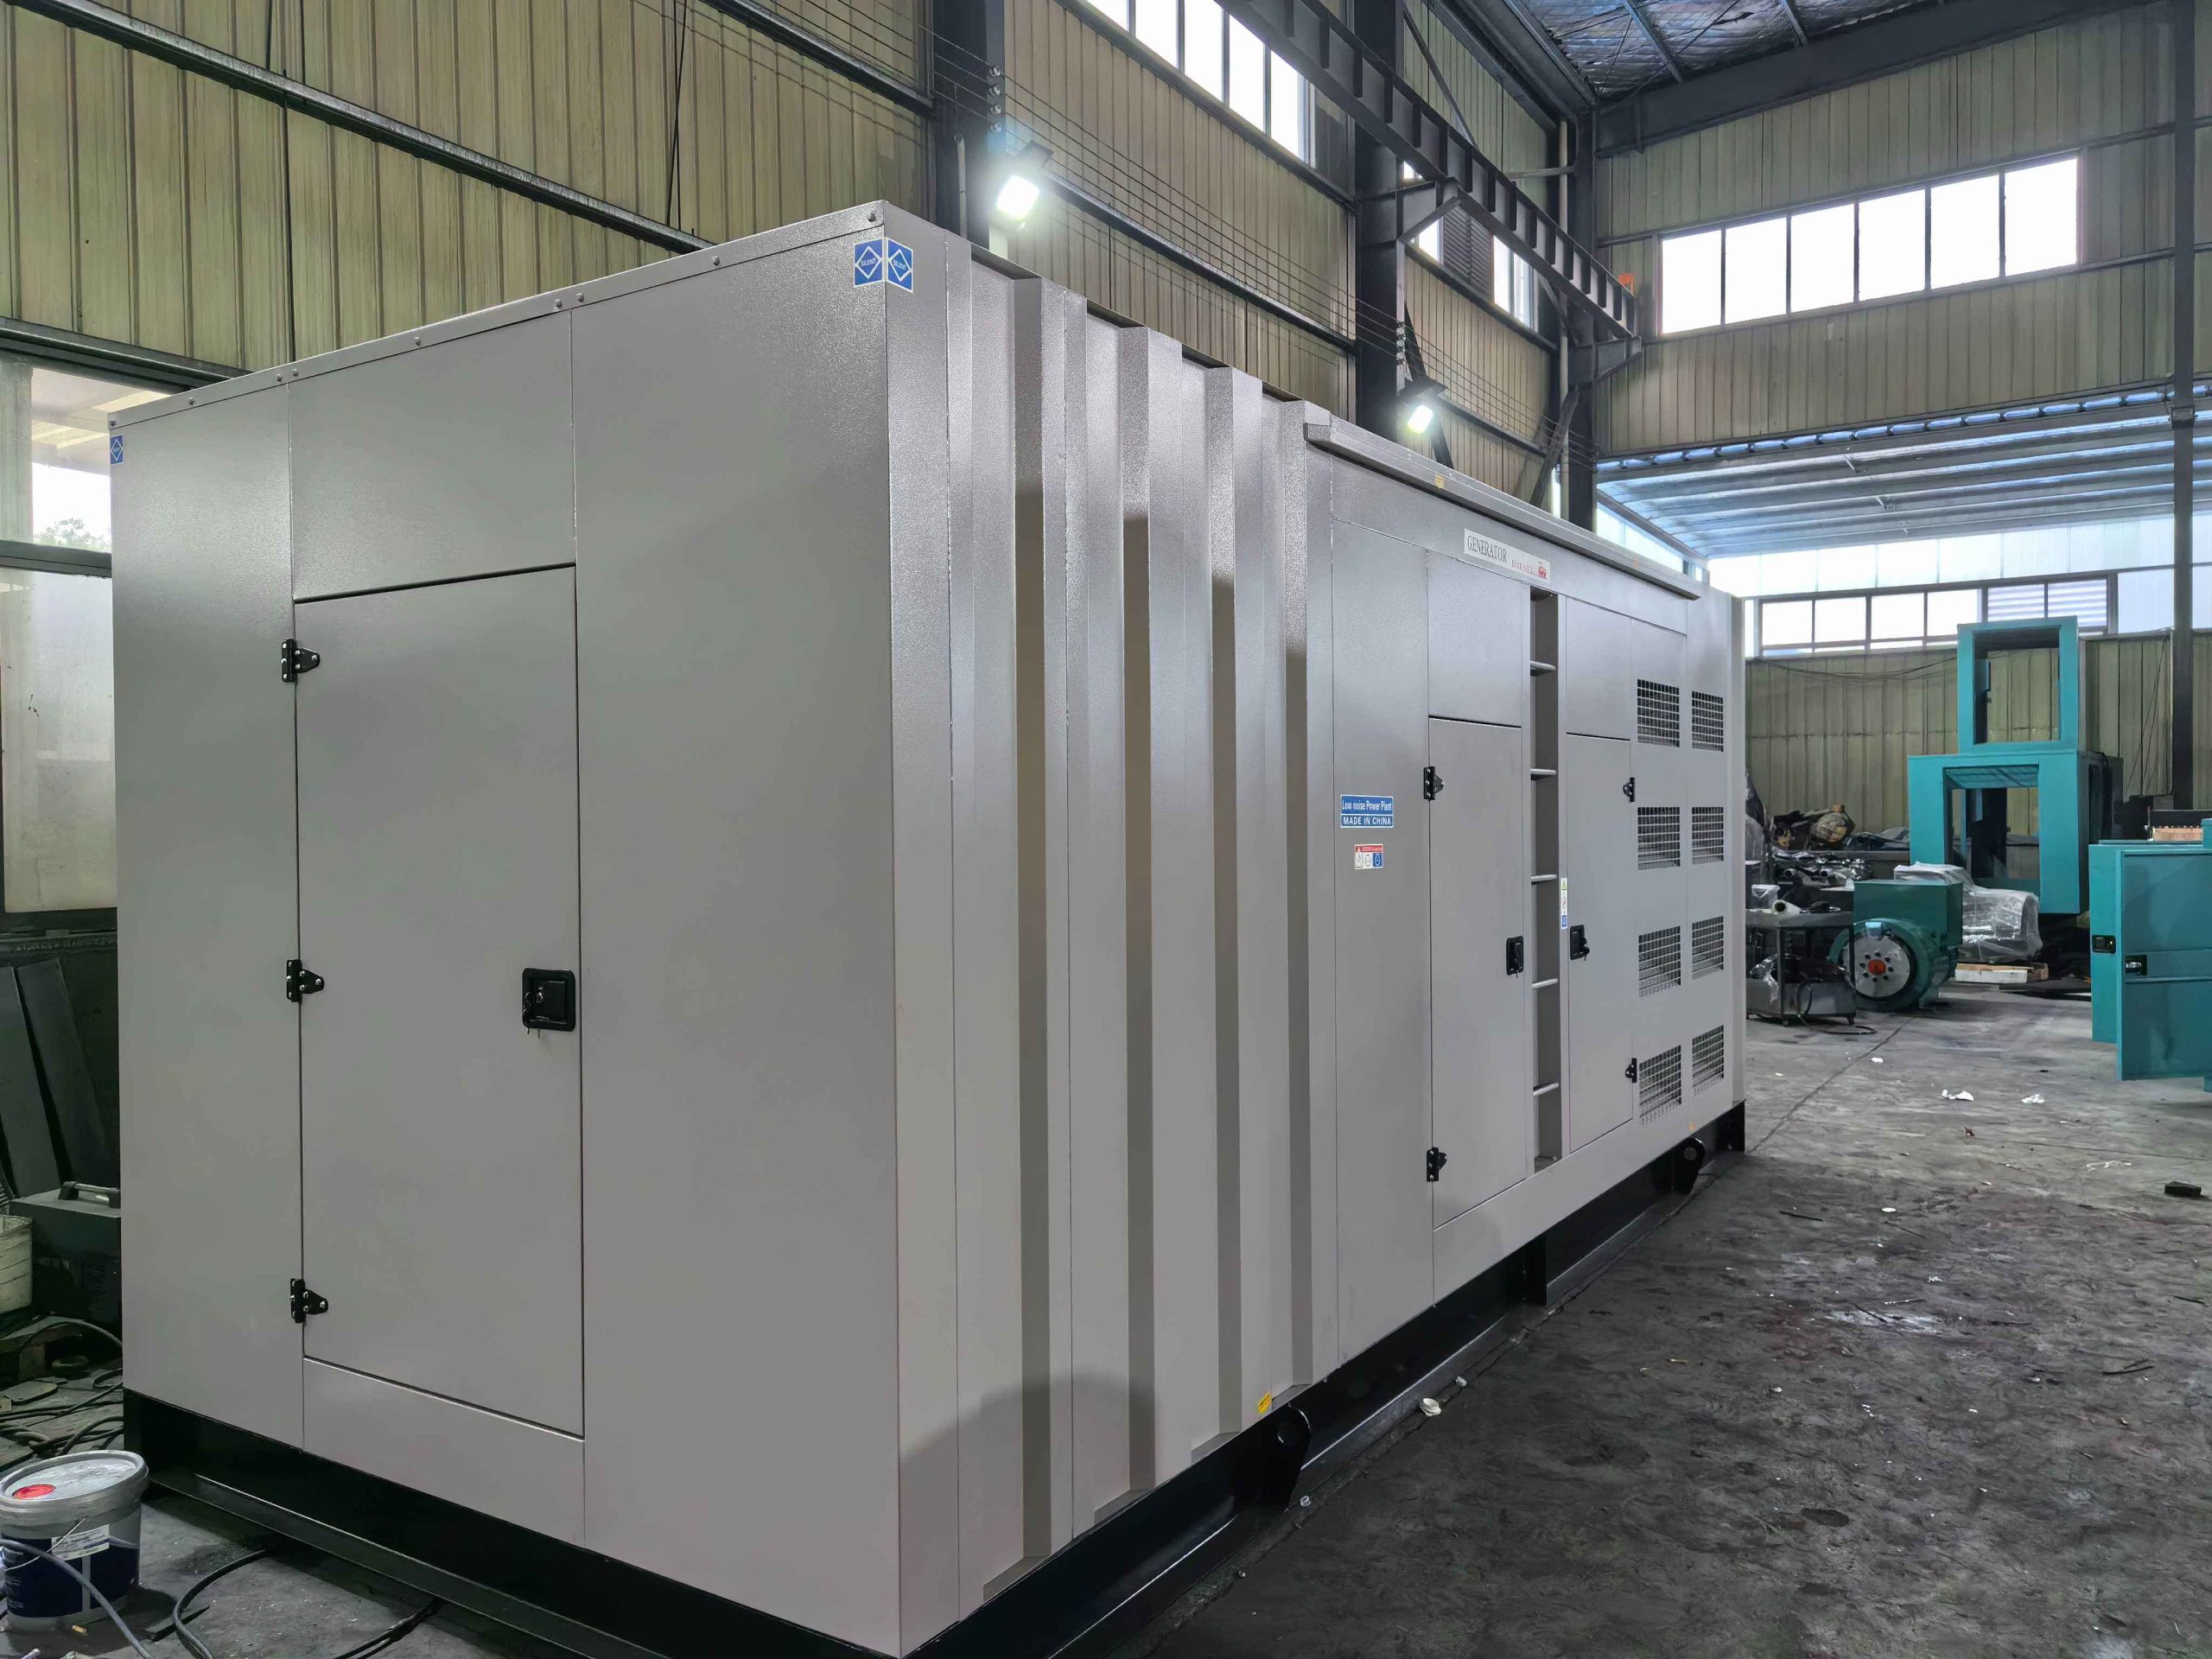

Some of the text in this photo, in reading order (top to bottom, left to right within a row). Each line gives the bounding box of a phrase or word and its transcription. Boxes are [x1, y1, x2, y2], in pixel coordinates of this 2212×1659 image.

[1467, 535, 1508, 563] GENERATOR
[1342, 799, 1392, 811] Low noise Power Plant
[1343, 817, 1391, 825] MADE IN CHINA
